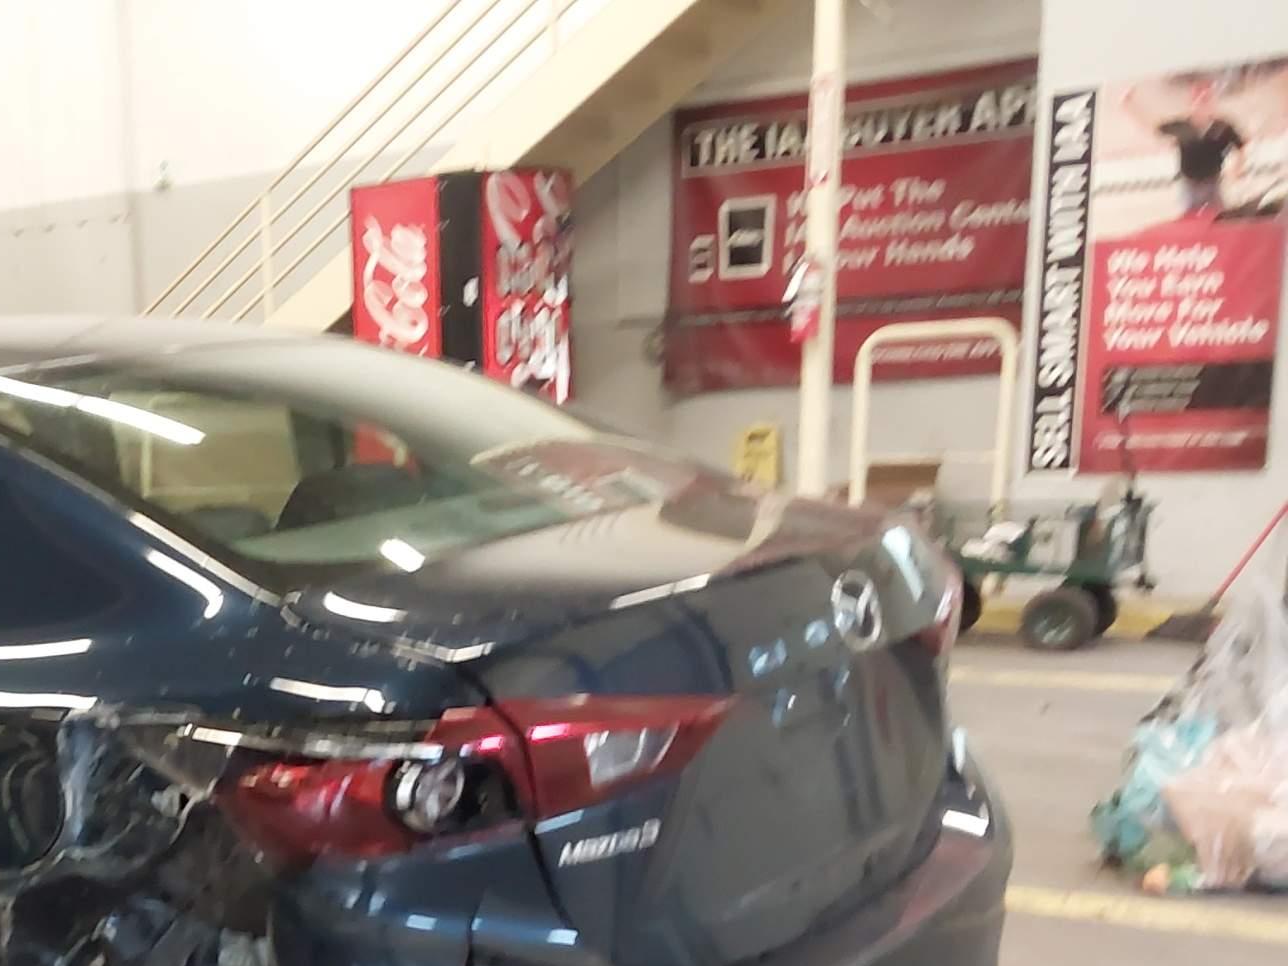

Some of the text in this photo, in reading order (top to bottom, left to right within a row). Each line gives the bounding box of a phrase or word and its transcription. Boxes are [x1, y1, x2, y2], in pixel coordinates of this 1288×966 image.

[693, 121, 759, 168] THE
[1031, 90, 1095, 469] SELL SMART WITH IAA
